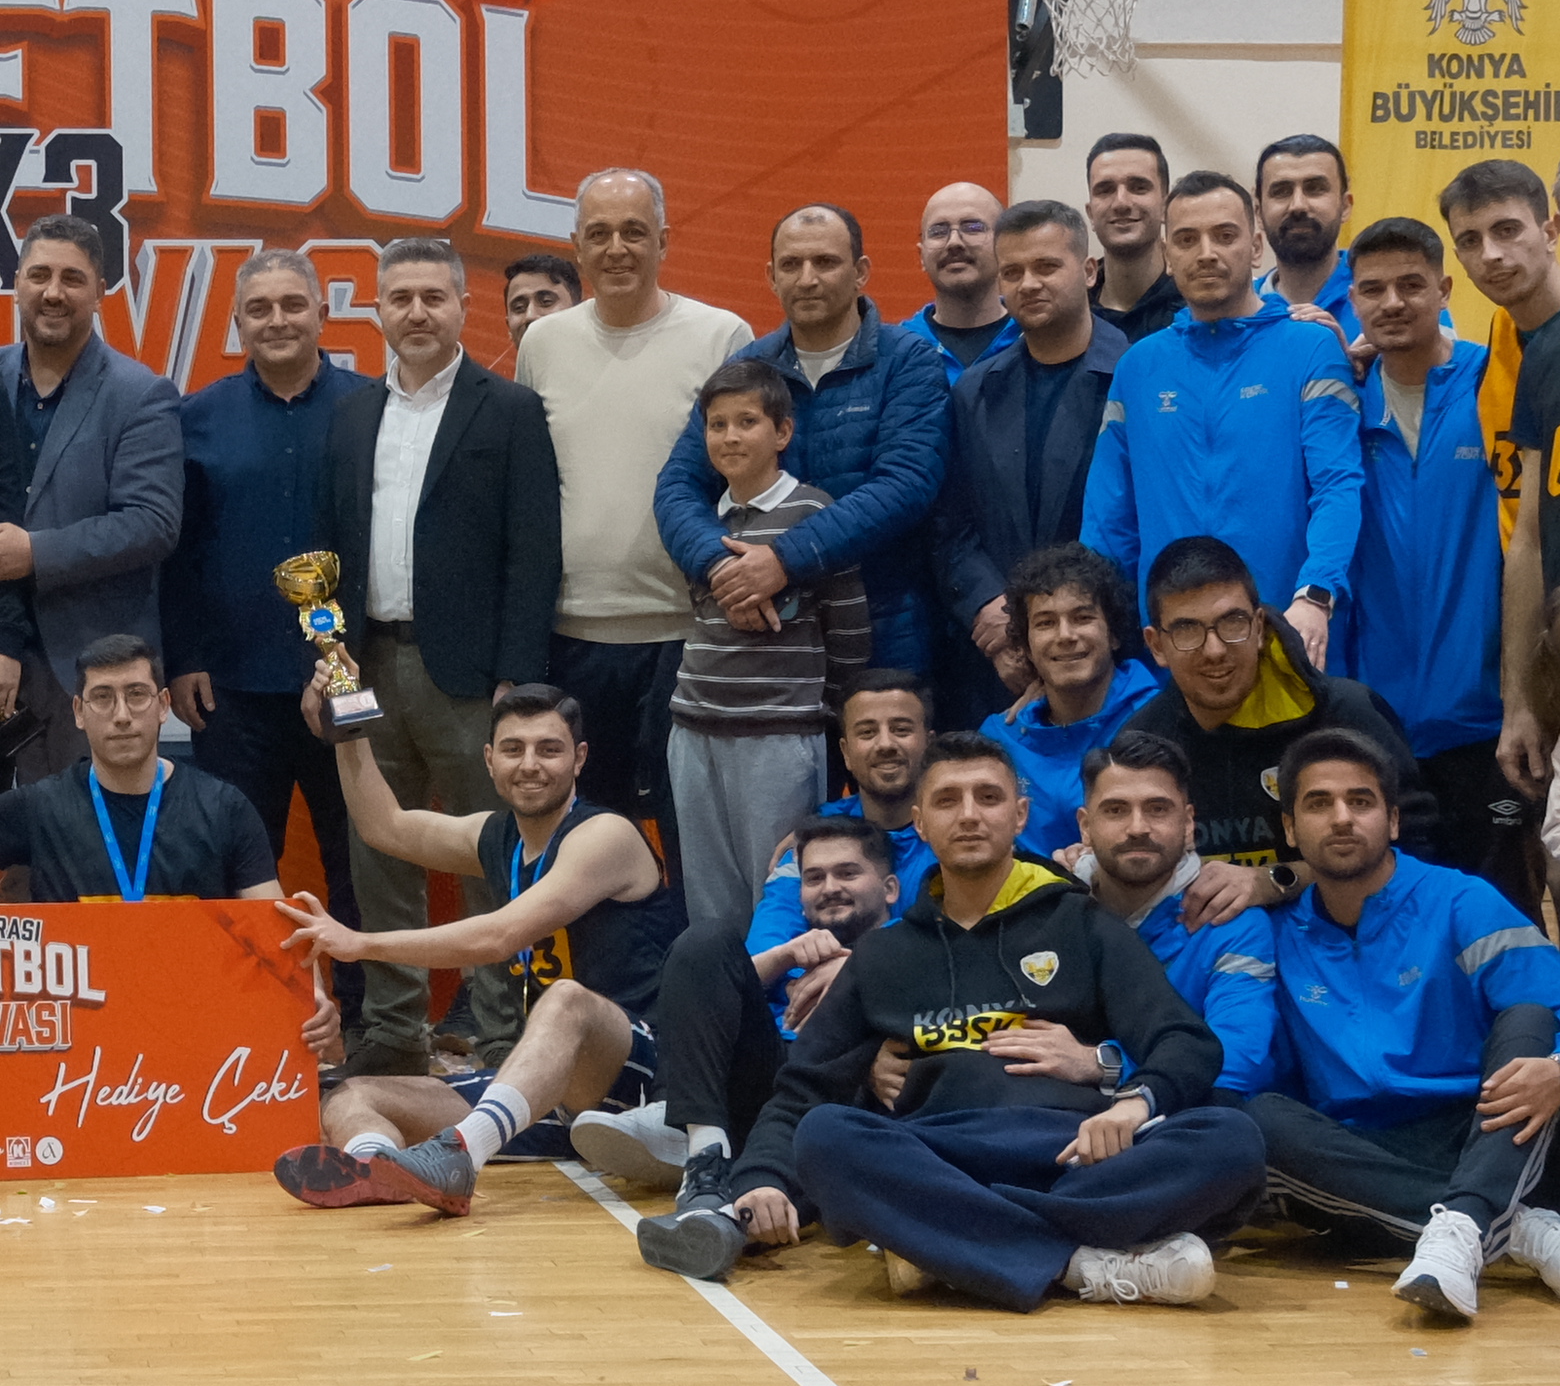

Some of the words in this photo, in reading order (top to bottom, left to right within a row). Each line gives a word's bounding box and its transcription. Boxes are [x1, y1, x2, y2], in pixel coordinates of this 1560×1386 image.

[1427, 53, 1526, 80] KONYA
[1414, 125, 1532, 150] BELEDİYESİ
[40, 1045, 184, 1143] Hediye
[202, 1046, 308, 1135] Çeki
